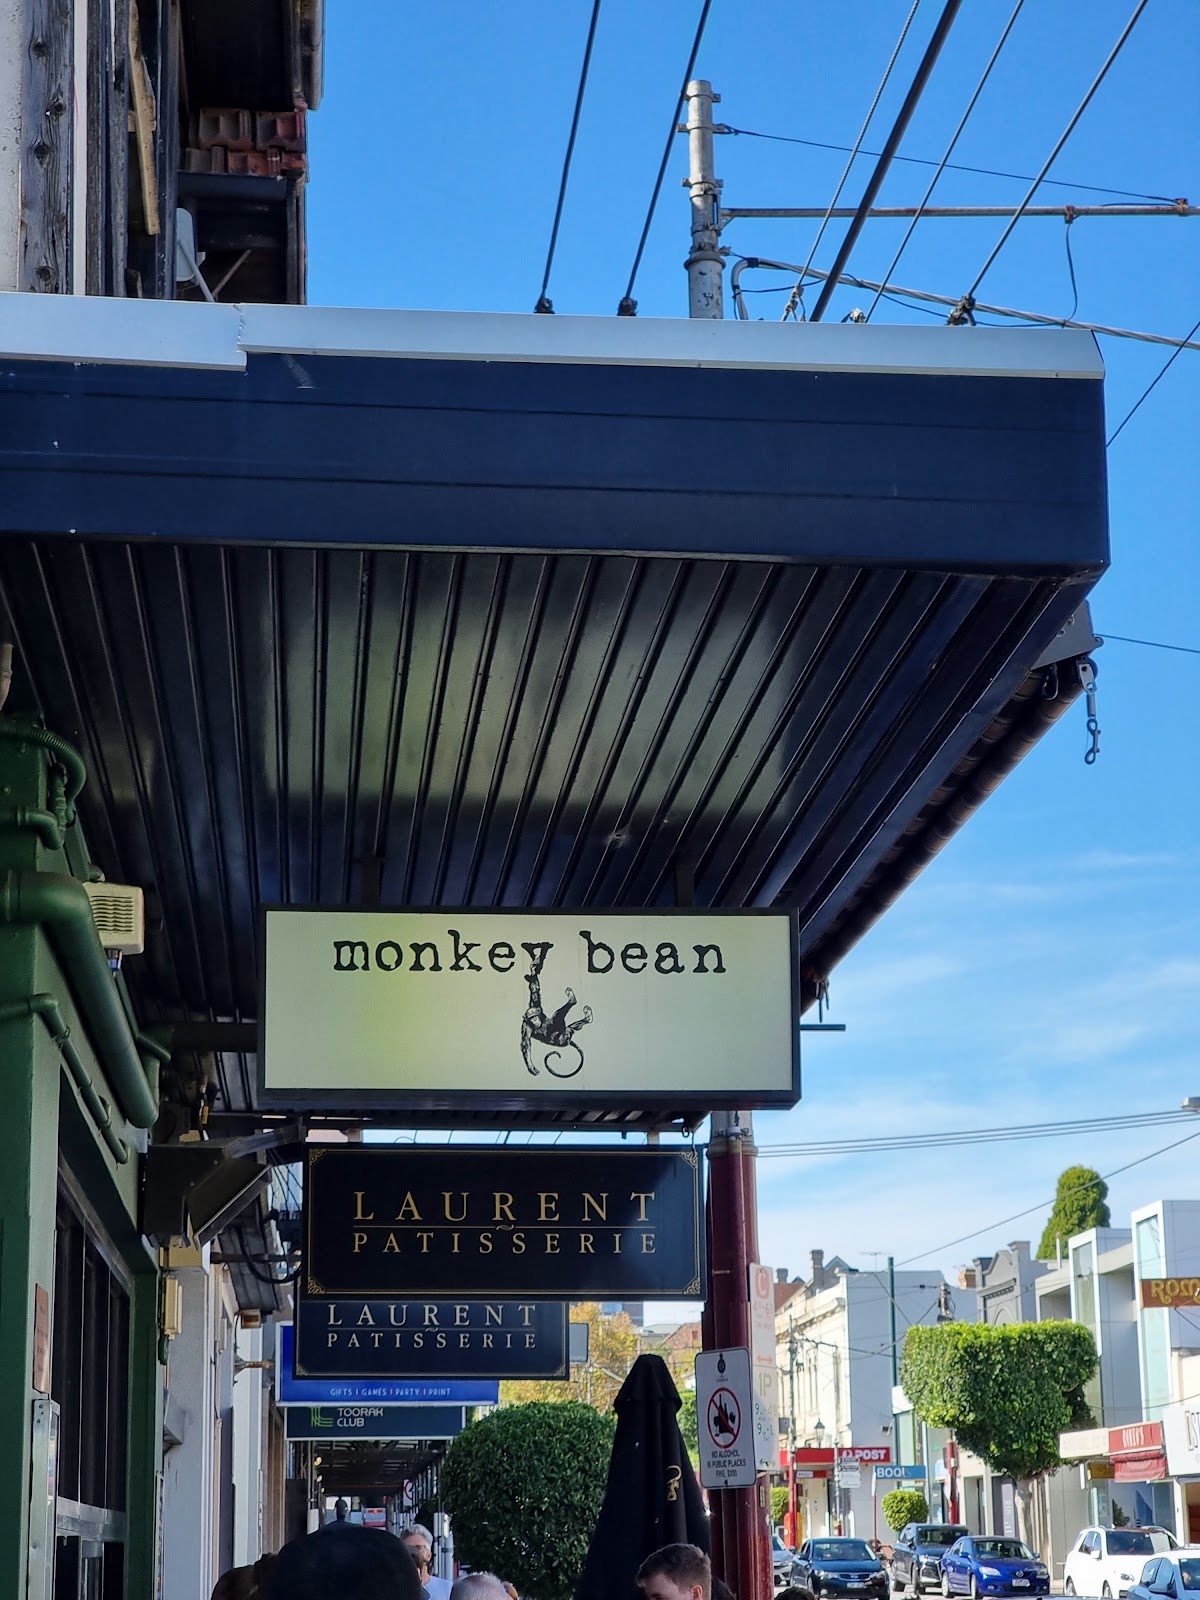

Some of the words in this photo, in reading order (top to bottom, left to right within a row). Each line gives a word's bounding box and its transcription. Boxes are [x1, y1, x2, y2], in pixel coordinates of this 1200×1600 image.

[333, 929, 554, 980] monkey
[579, 930, 727, 974] bean
[353, 1190, 656, 1222] LAURENT
[353, 1232, 656, 1254] PATISSERIE
[327, 1304, 536, 1326] LAURENT
[327, 1333, 536, 1349] PATISSERIE
[330, 1388, 353, 1397] GIFTS
[361, 1388, 386, 1397] GAMES
[395, 1388, 420, 1396] PARTY
[428, 1388, 451, 1396] PRINT
[338, 1407, 384, 1418] TOORAK
[336, 1417, 365, 1428] CLUB
[854, 1450, 887, 1460] POST
[728, 1459, 747, 1467] PLACES
